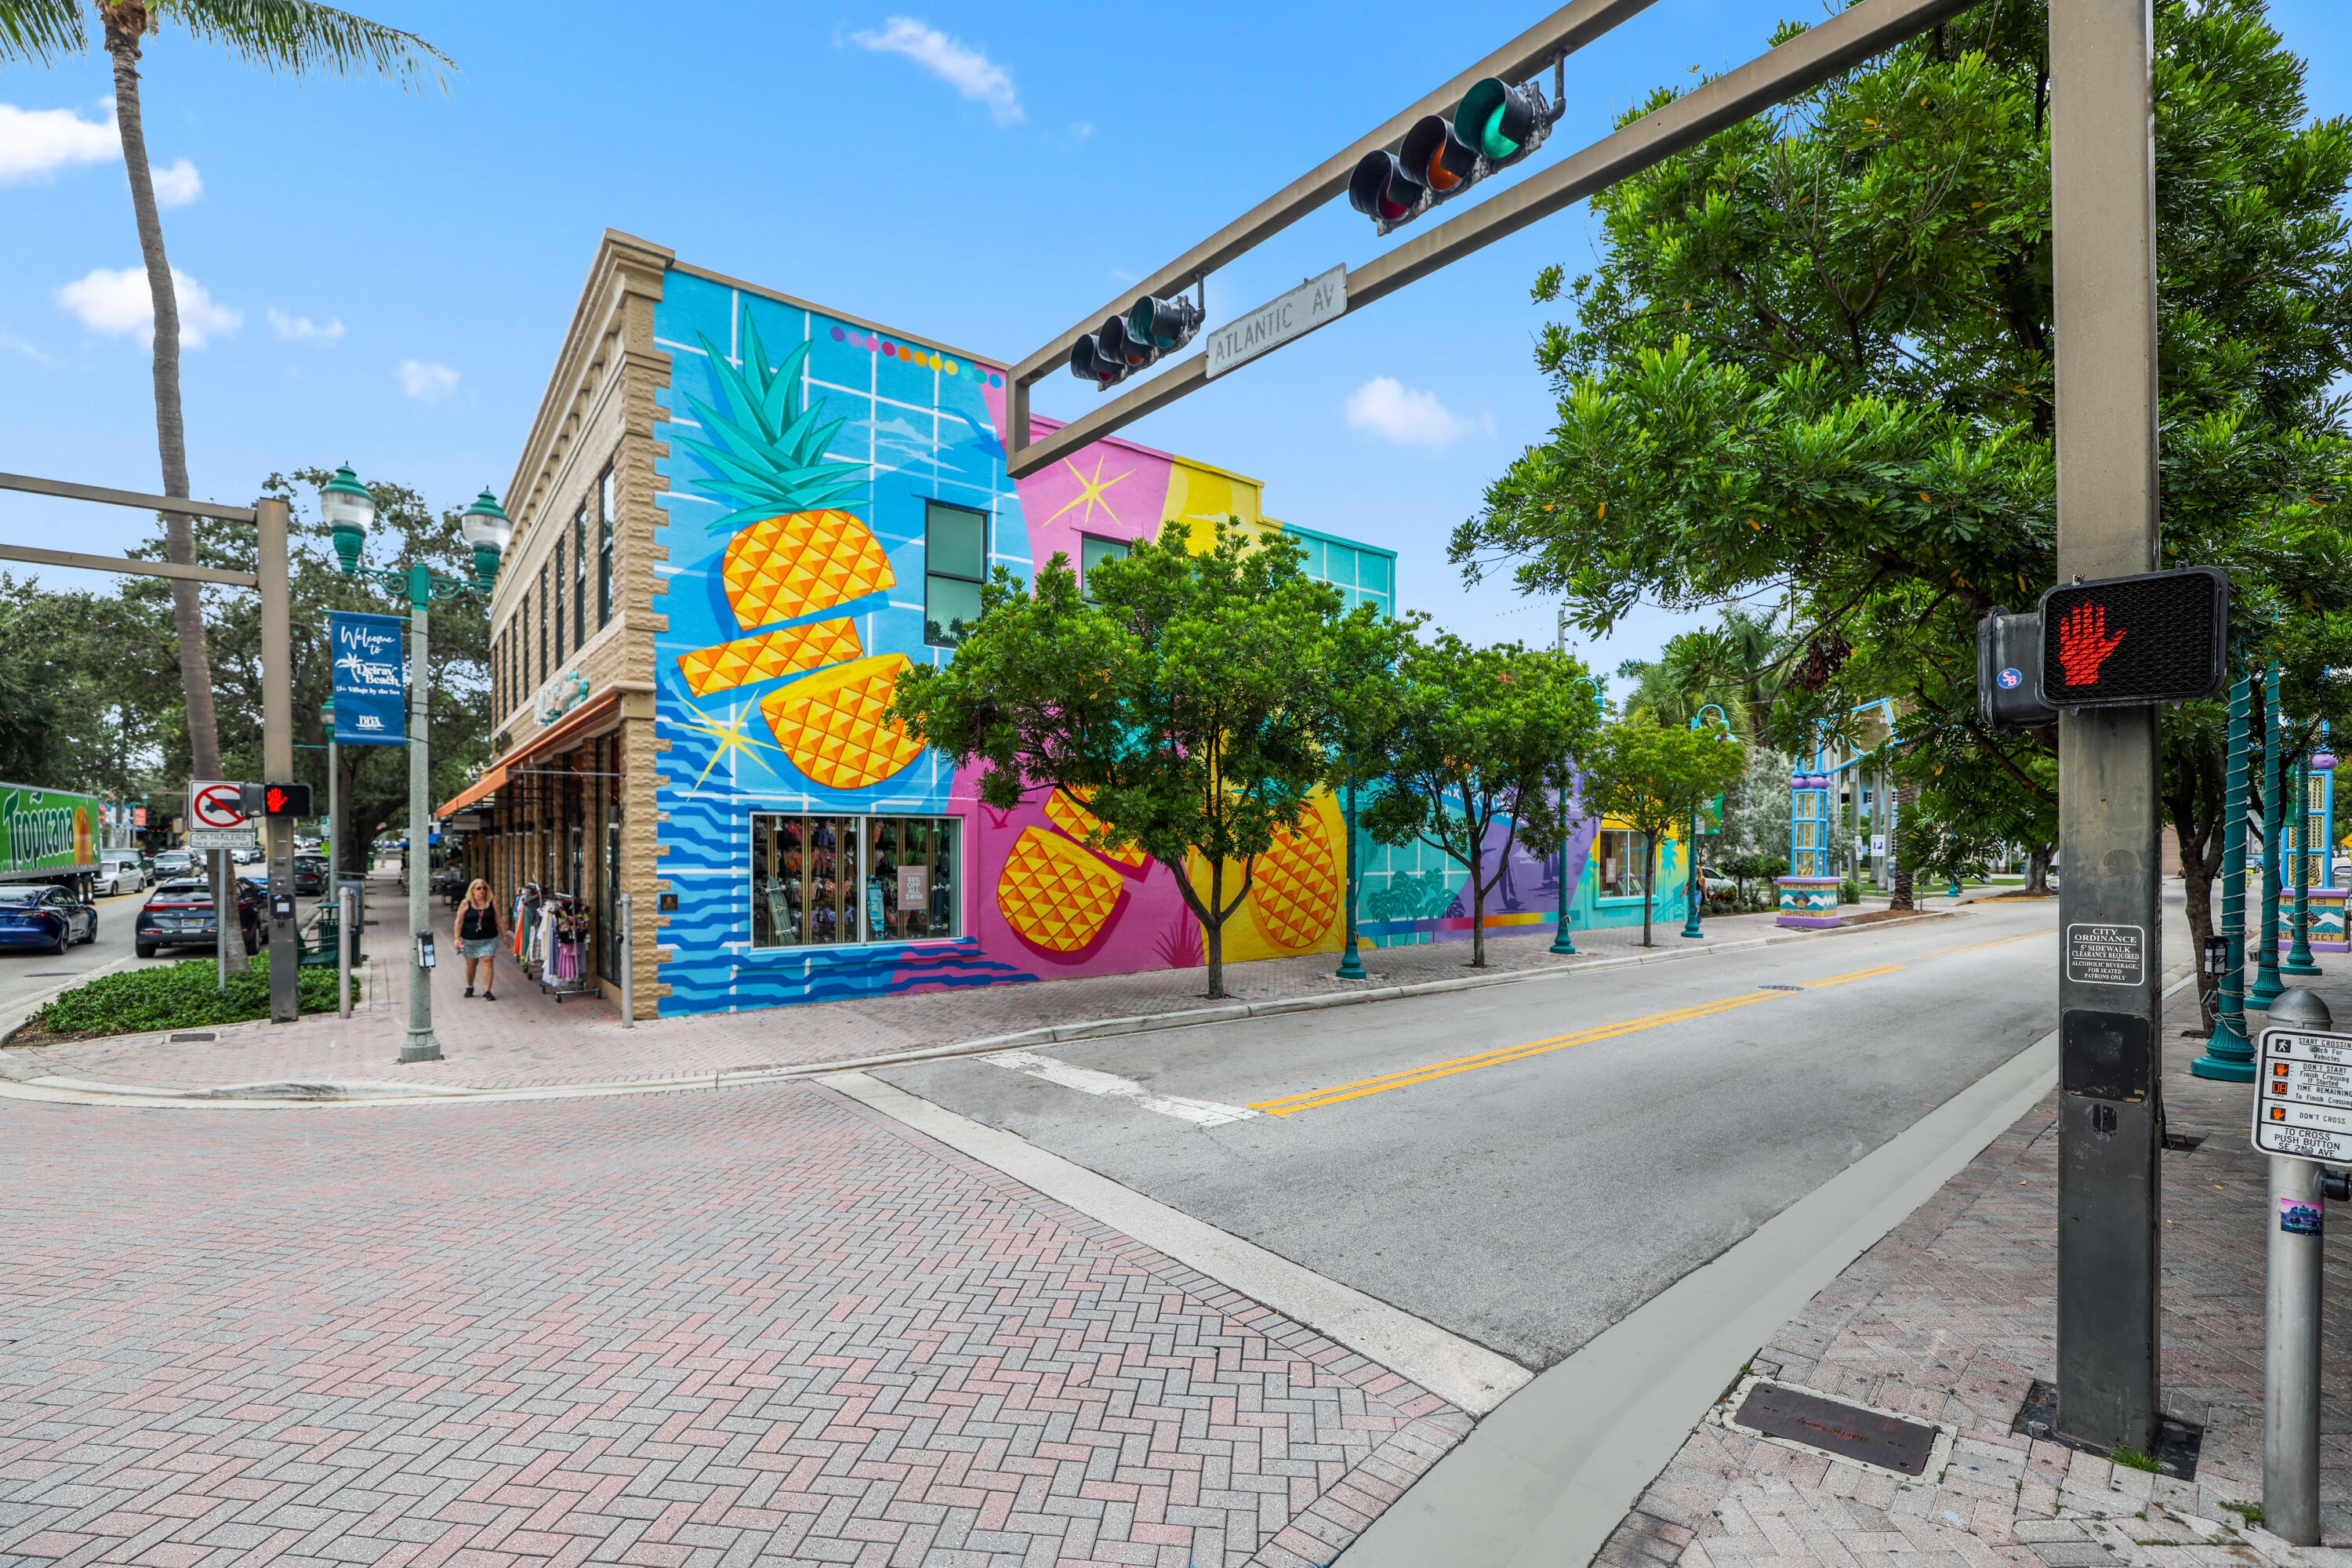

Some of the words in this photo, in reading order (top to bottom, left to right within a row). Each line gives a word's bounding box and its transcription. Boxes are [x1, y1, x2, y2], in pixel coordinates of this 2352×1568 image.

[1215, 303, 1292, 364] ATLANTIC
[1312, 284, 1334, 314] AV
[340, 626, 395, 650] Welcome
[369, 644, 383, 655] to
[356, 664, 398, 676] Delray
[361, 674, 401, 687] Beach
[3, 789, 74, 870] Tropicana
[2074, 935, 2136, 943] ORDINANCE
[2321, 1040, 2352, 1049] CROSSIN
[2326, 1065, 2347, 1074] START
[2322, 1073, 2349, 1083] Crossing
[2316, 1087, 2352, 1097] REMAINING
[2299, 1112, 2319, 1120] DON'T
[2323, 1115, 2346, 1124] CROSS
[2285, 1127, 2296, 1136] TO
[2299, 1129, 2331, 1141] CROSS
[2274, 1134, 2299, 1144] PUSH
[2303, 1138, 2340, 1150] BUTTON
[2278, 1142, 2290, 1151] SE
[2318, 1148, 2336, 1158] AVE
